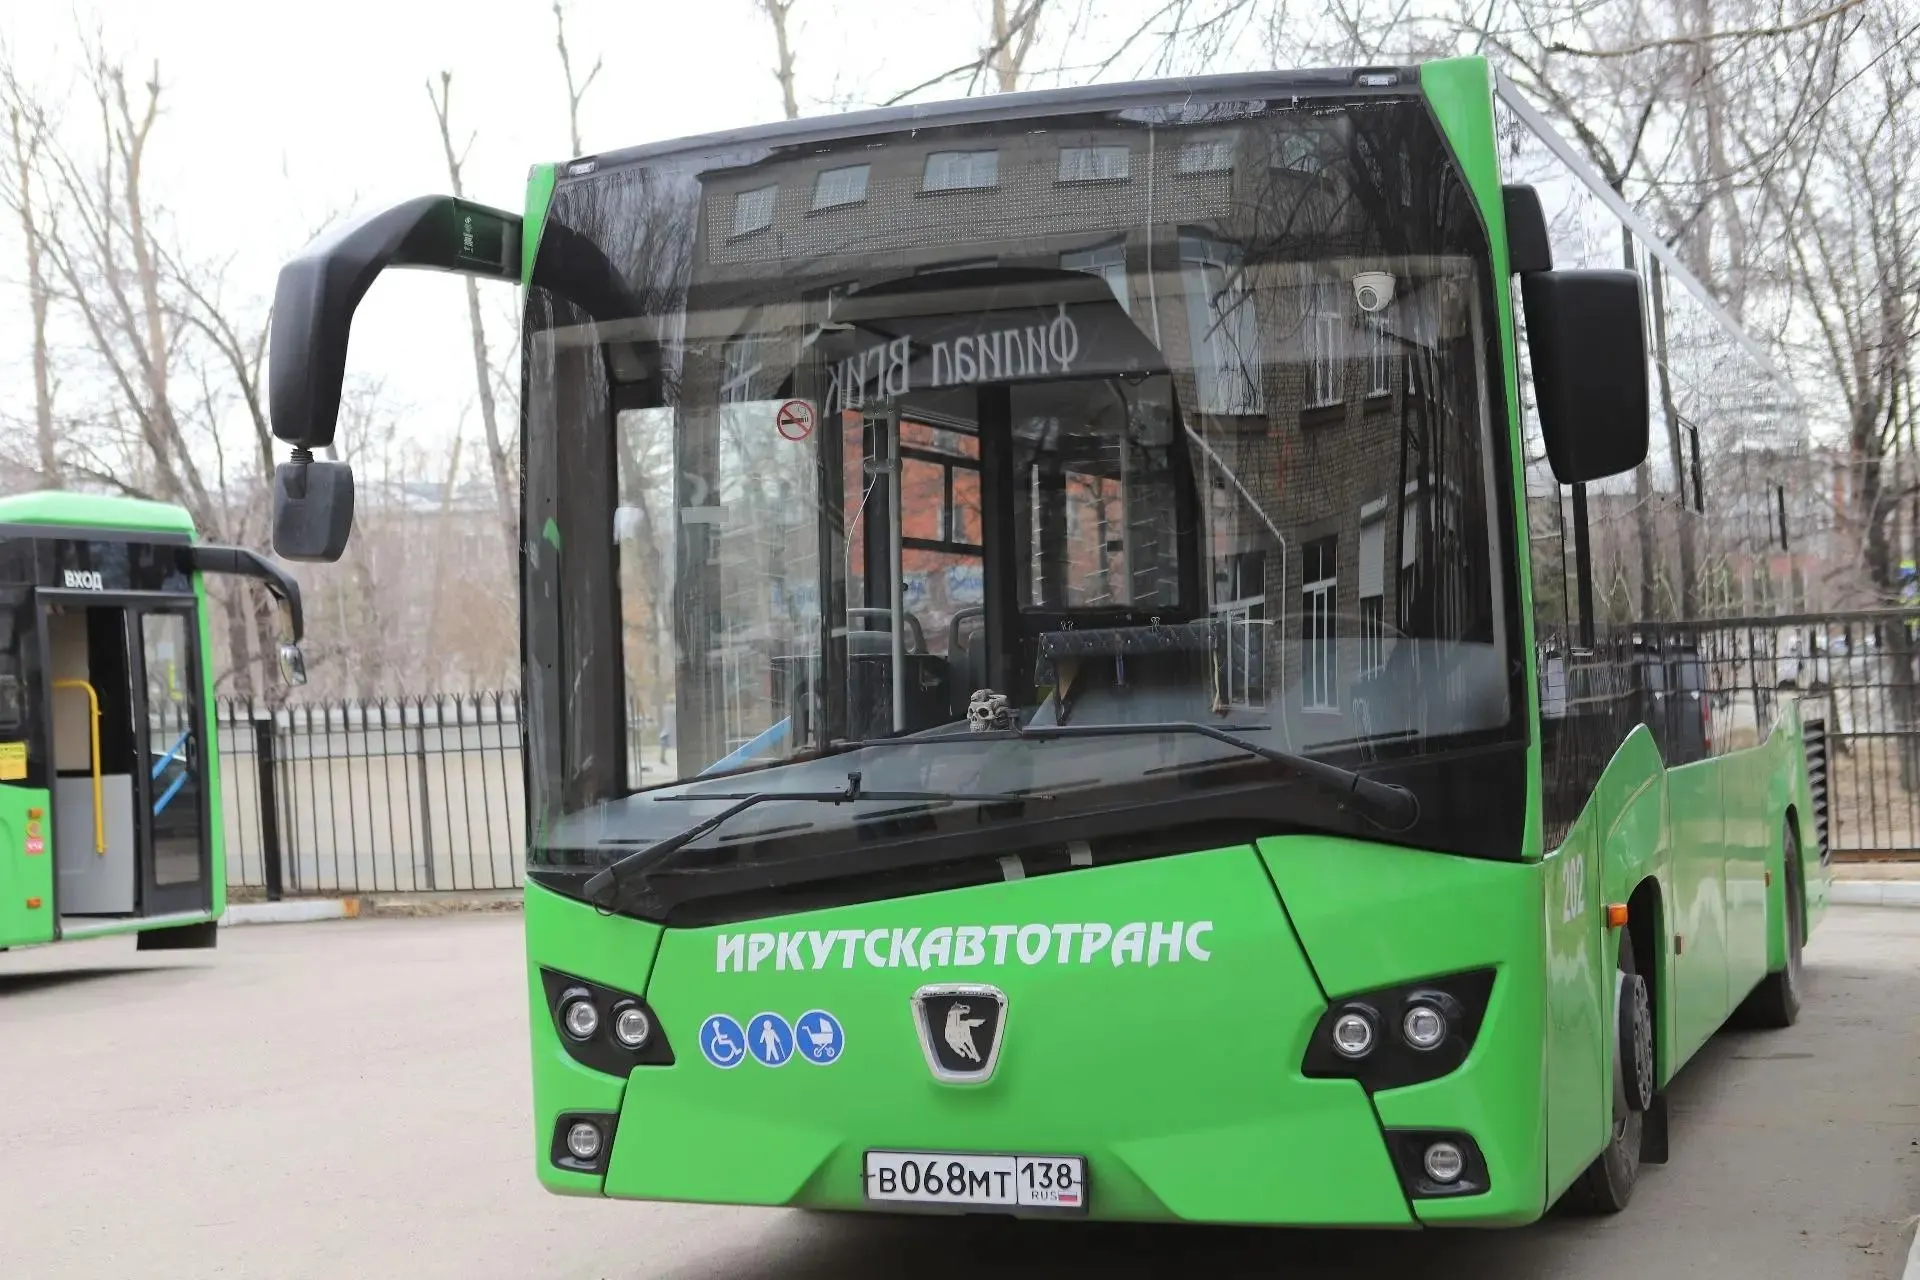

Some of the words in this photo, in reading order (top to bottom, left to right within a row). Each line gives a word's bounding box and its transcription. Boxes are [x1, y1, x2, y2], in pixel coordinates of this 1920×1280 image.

[64, 569, 103, 592] ВХОД
[1562, 853, 1584, 924] 202
[716, 921, 1213, 972] ИРКУТСКАВТОТРАНС
[879, 1160, 1012, 1198] В068МТ
[1021, 1162, 1073, 1189] 138
[1031, 1190, 1057, 1200] RUS
